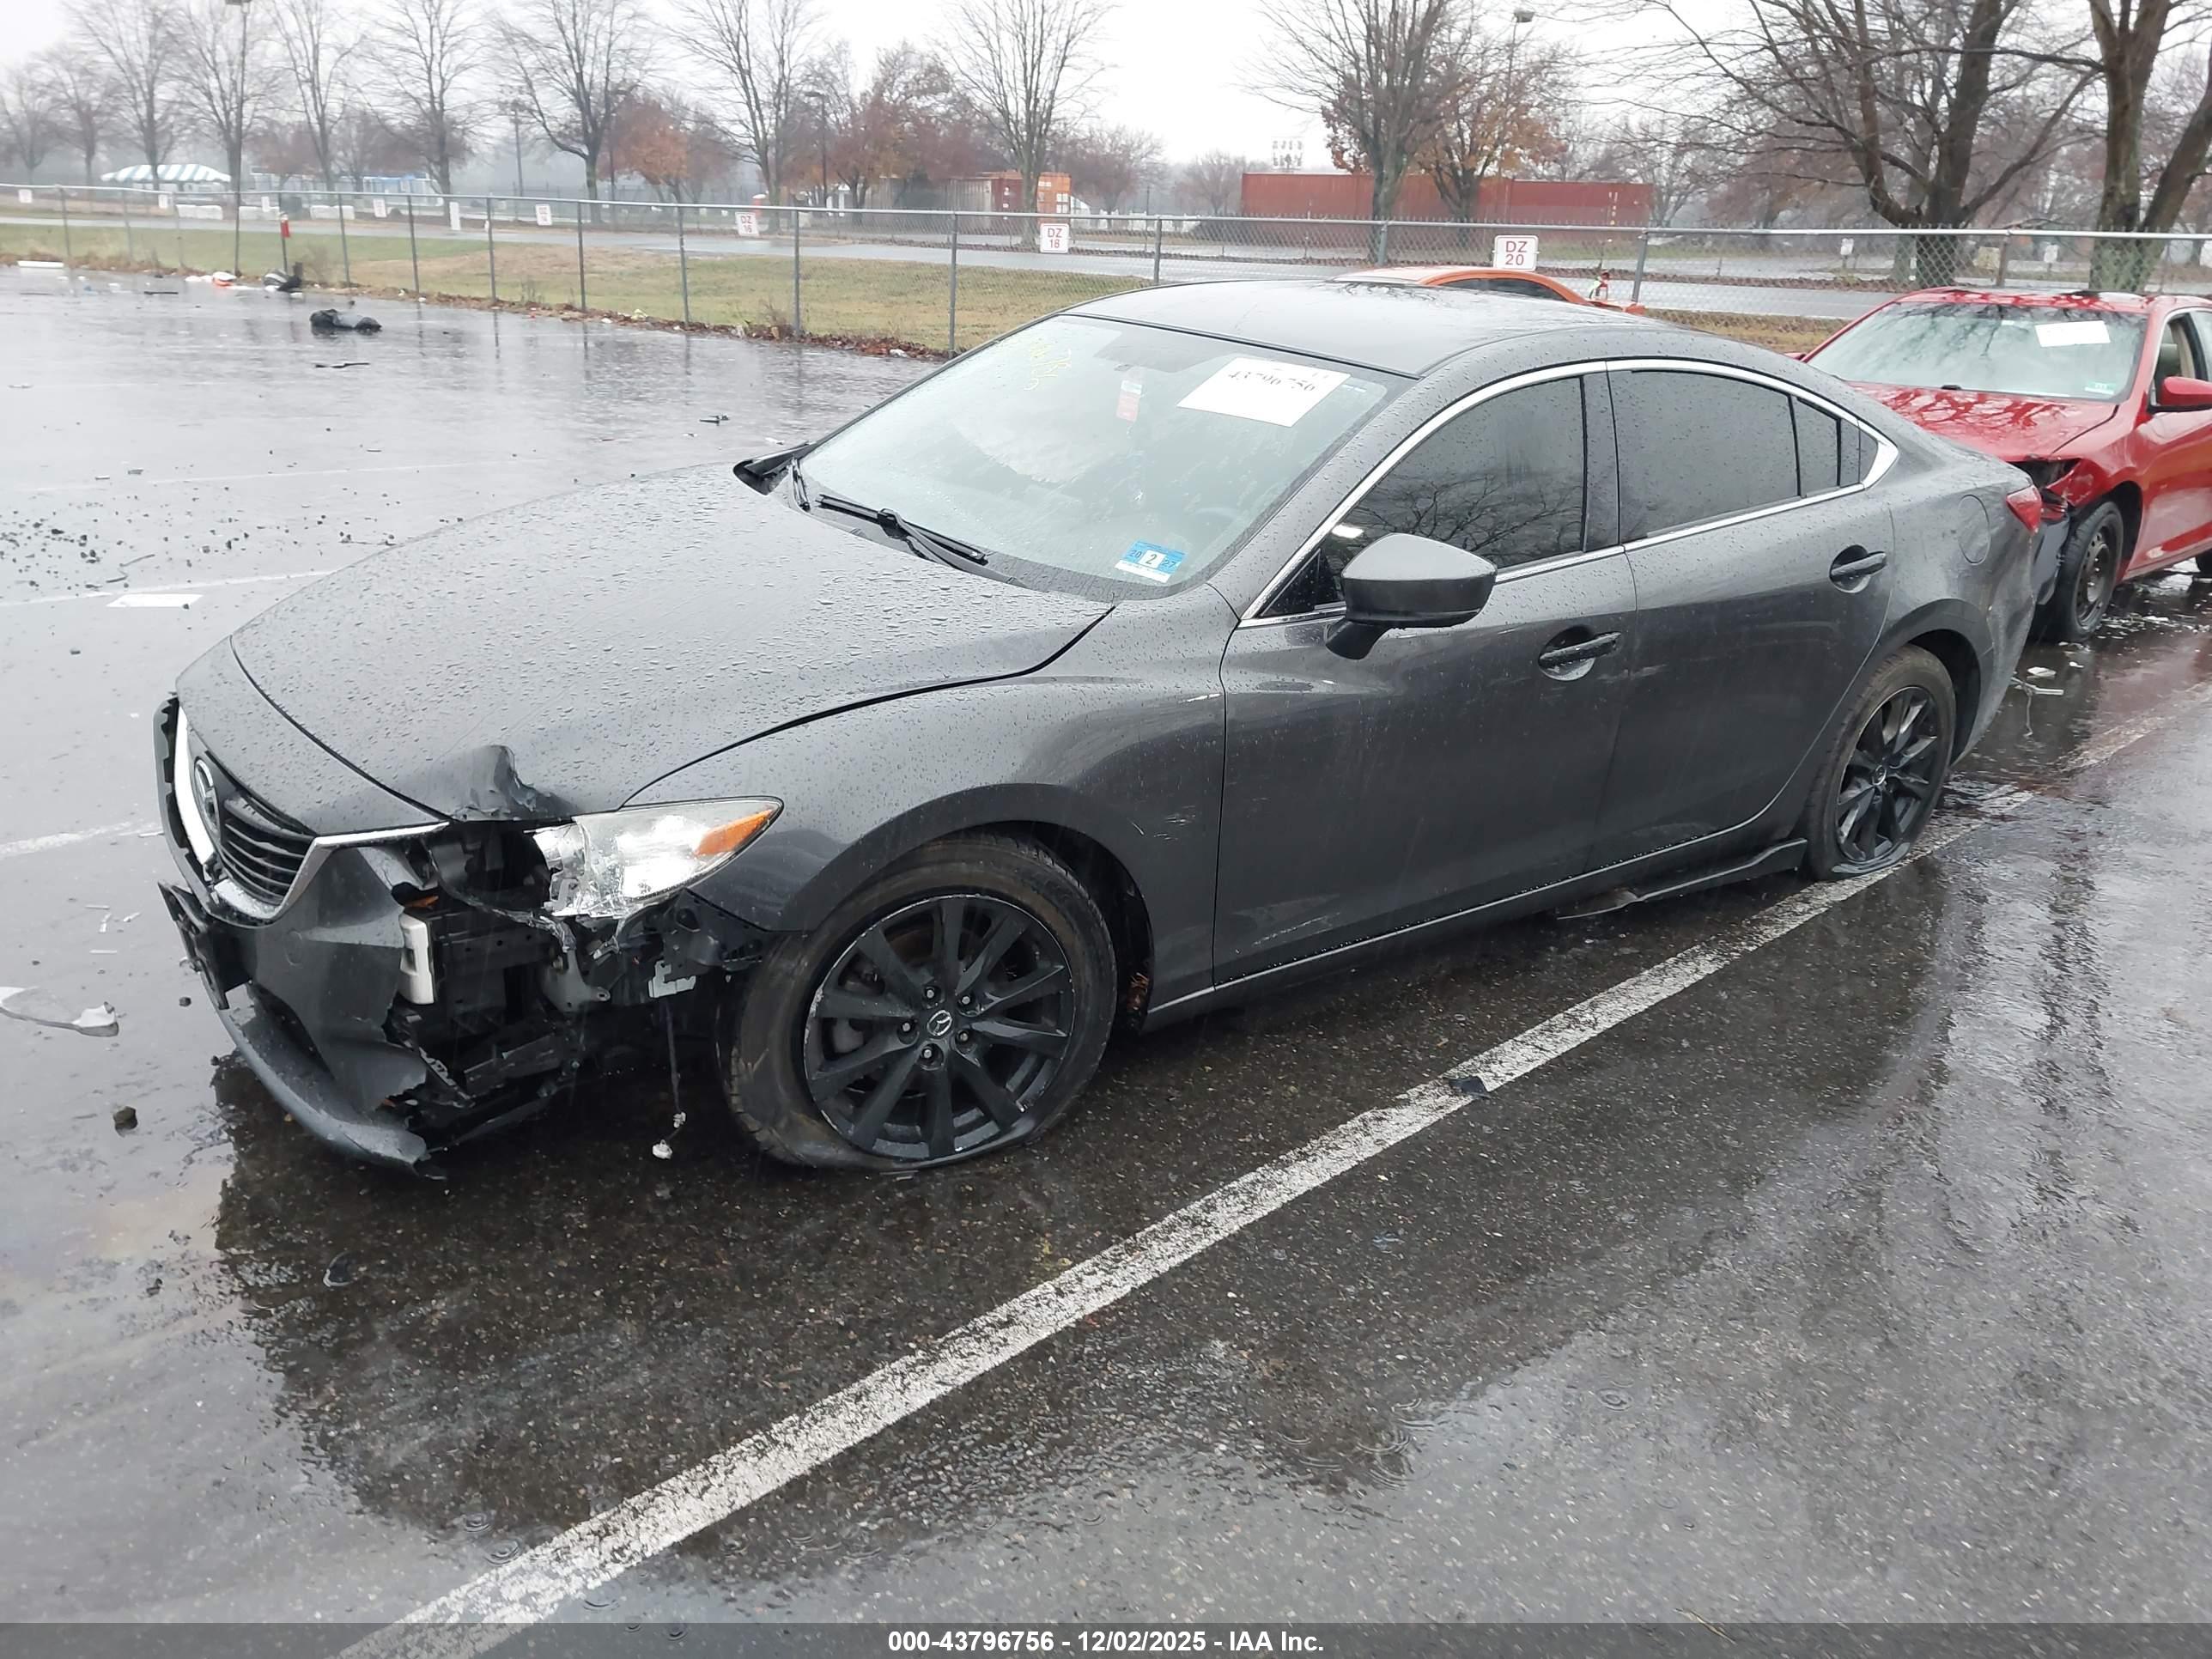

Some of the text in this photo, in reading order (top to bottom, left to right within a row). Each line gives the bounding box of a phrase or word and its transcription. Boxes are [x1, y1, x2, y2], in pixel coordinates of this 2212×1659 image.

[741, 215, 753, 224] DZ
[1048, 228, 1063, 239] DZ
[1049, 239, 1060, 249] 18
[1505, 240, 1528, 253] DZ
[1505, 254, 1525, 266] 20
[1129, 550, 1177, 568] 20 2 27
